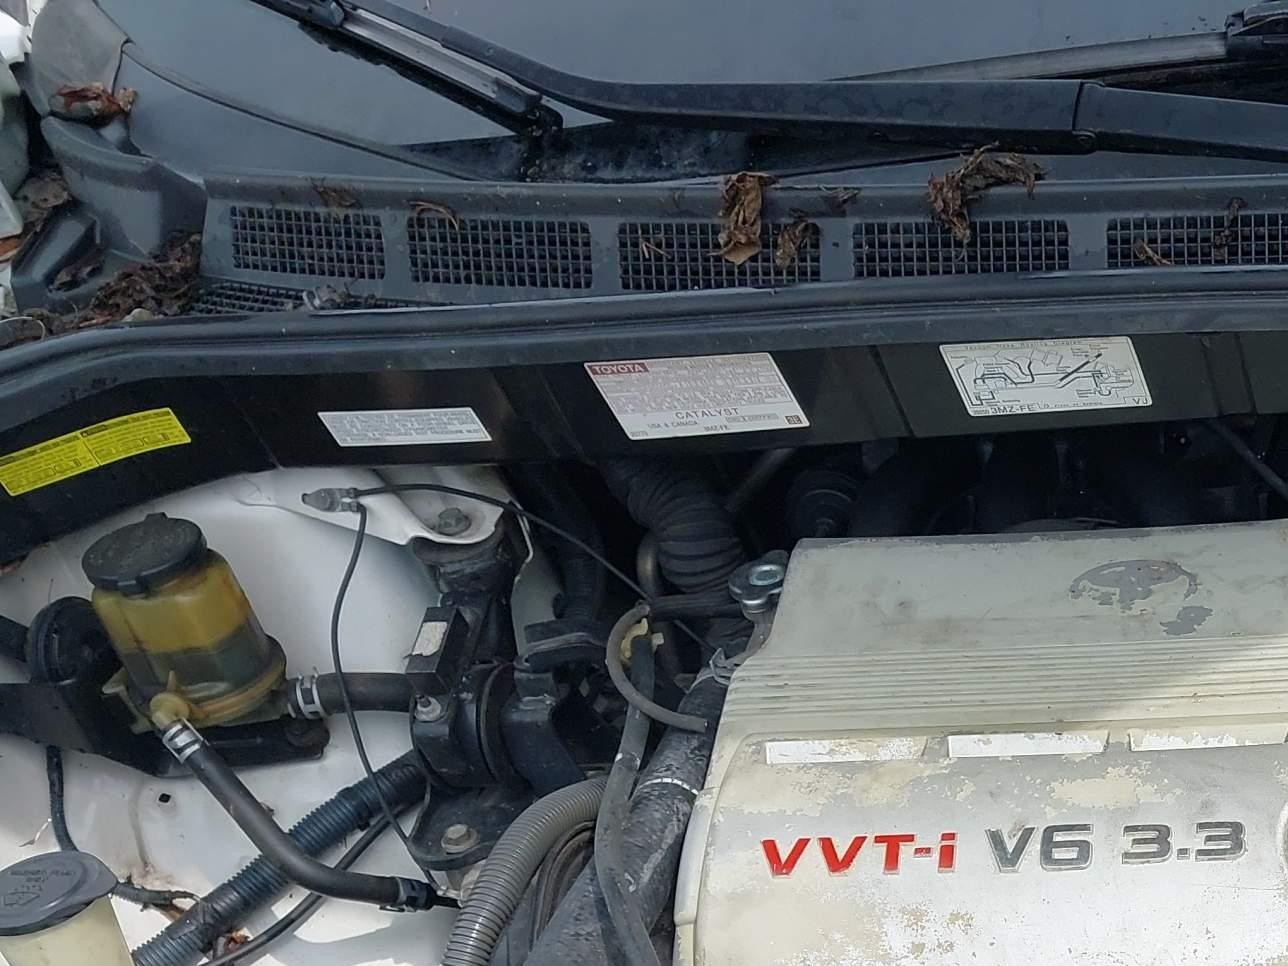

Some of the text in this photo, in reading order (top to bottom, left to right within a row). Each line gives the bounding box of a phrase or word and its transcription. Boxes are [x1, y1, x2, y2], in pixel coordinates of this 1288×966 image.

[592, 363, 645, 374] TOYOTA
[675, 407, 740, 420] CATALYST
[761, 821, 1247, 879] VVT-i V6 3.3
